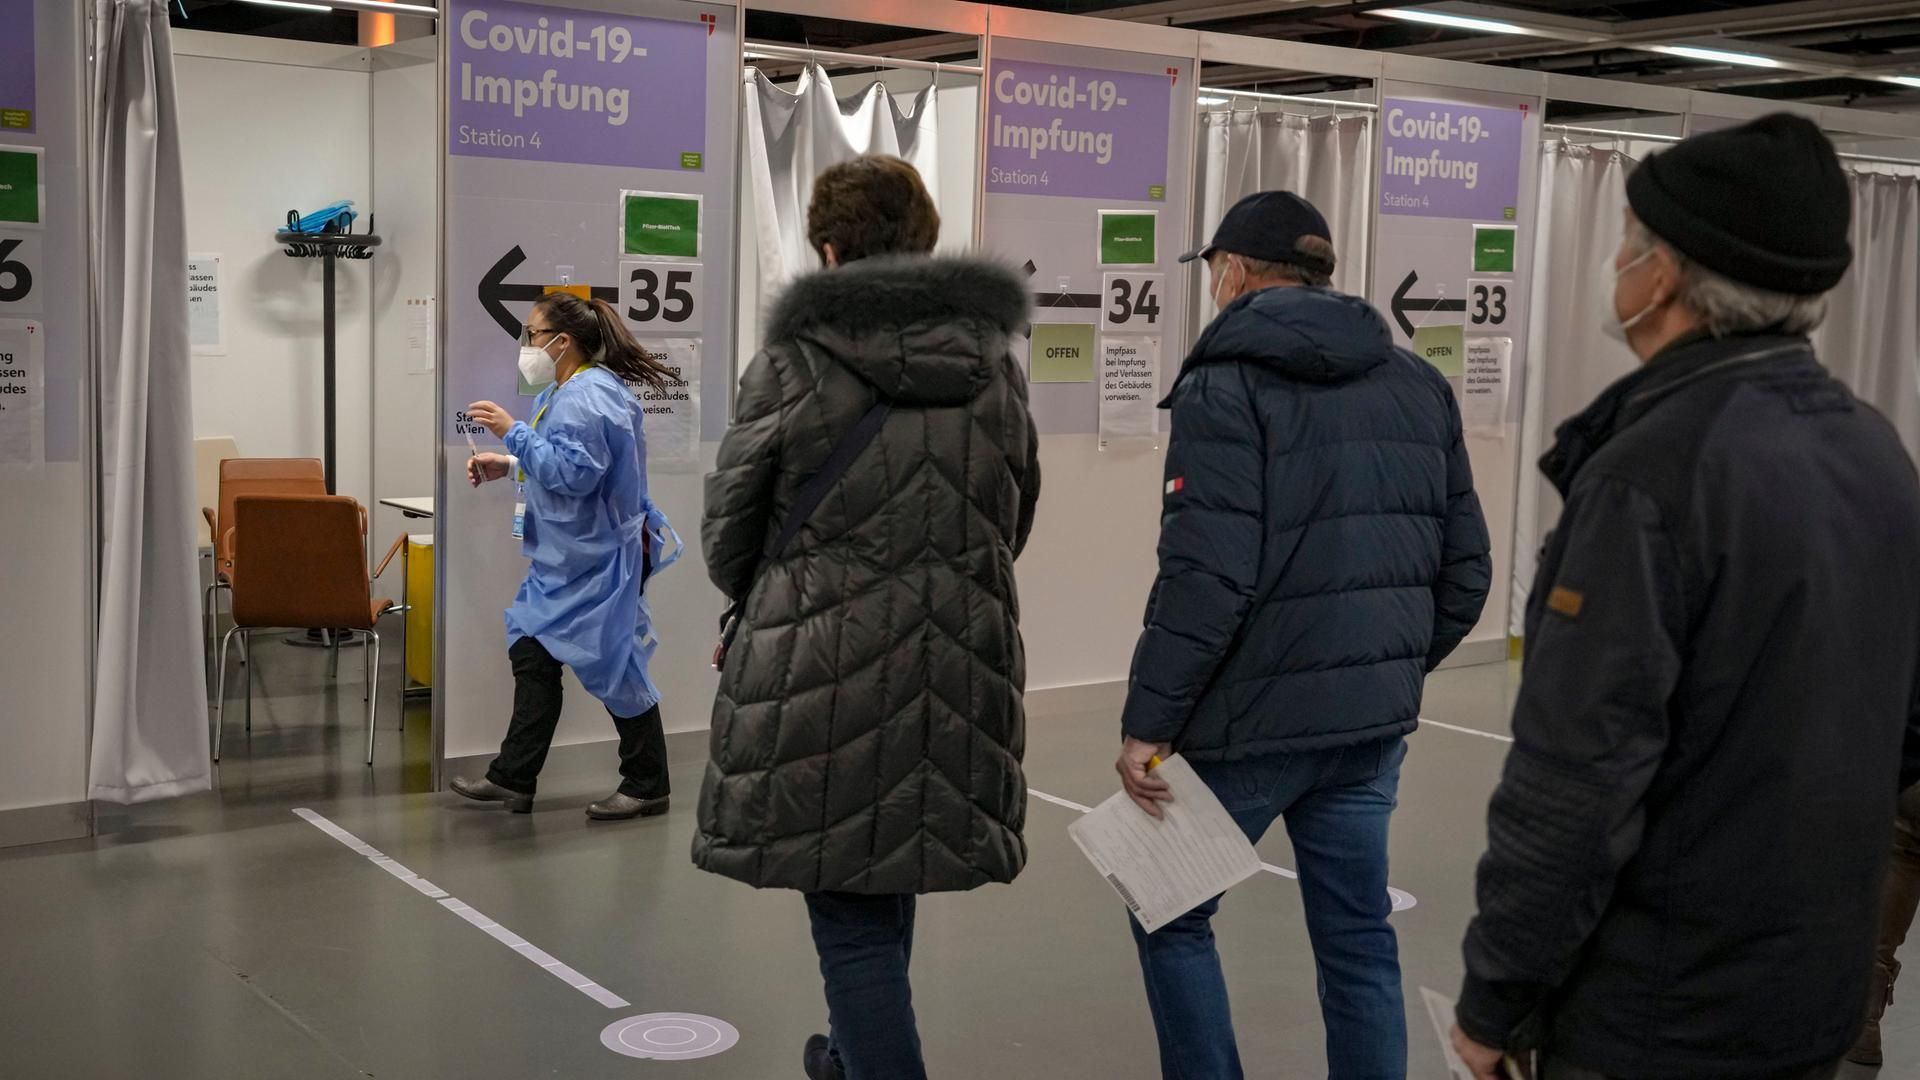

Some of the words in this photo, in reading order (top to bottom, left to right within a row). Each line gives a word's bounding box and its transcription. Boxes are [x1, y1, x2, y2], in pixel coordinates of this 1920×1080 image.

[460, 9, 648, 64] Covid-19-
[461, 62, 630, 126] Impfung
[994, 70, 1128, 112] Covid-19-
[1387, 108, 1489, 143] Covid-19-
[458, 125, 525, 148] Station
[529, 131, 542, 149] 4
[993, 114, 1114, 165] Impfung
[991, 167, 1038, 186] Station
[1039, 171, 1049, 185] 4
[1385, 146, 1479, 189] Impfung
[1383, 191, 1421, 208] Station
[1421, 195, 1430, 208] 4
[627, 269, 695, 323] 35
[1108, 278, 1160, 324] 34
[1471, 284, 1507, 325] 33
[1045, 347, 1080, 359] OFFEN
[1106, 346, 1137, 357] Impfpass
[1426, 346, 1453, 358] OFFEN
[1105, 357, 1116, 366] bei
[1117, 357, 1146, 368] Impfung
[1105, 369, 1119, 378] und
[1119, 369, 1153, 378] Verlassen
[1104, 380, 1118, 389] des
[1118, 380, 1152, 389] Gebäudes
[1104, 392, 1142, 401] vorweisen.
[455, 411, 476, 423] Sta
[642, 404, 674, 414] weisen.
[455, 423, 486, 434] Wien
